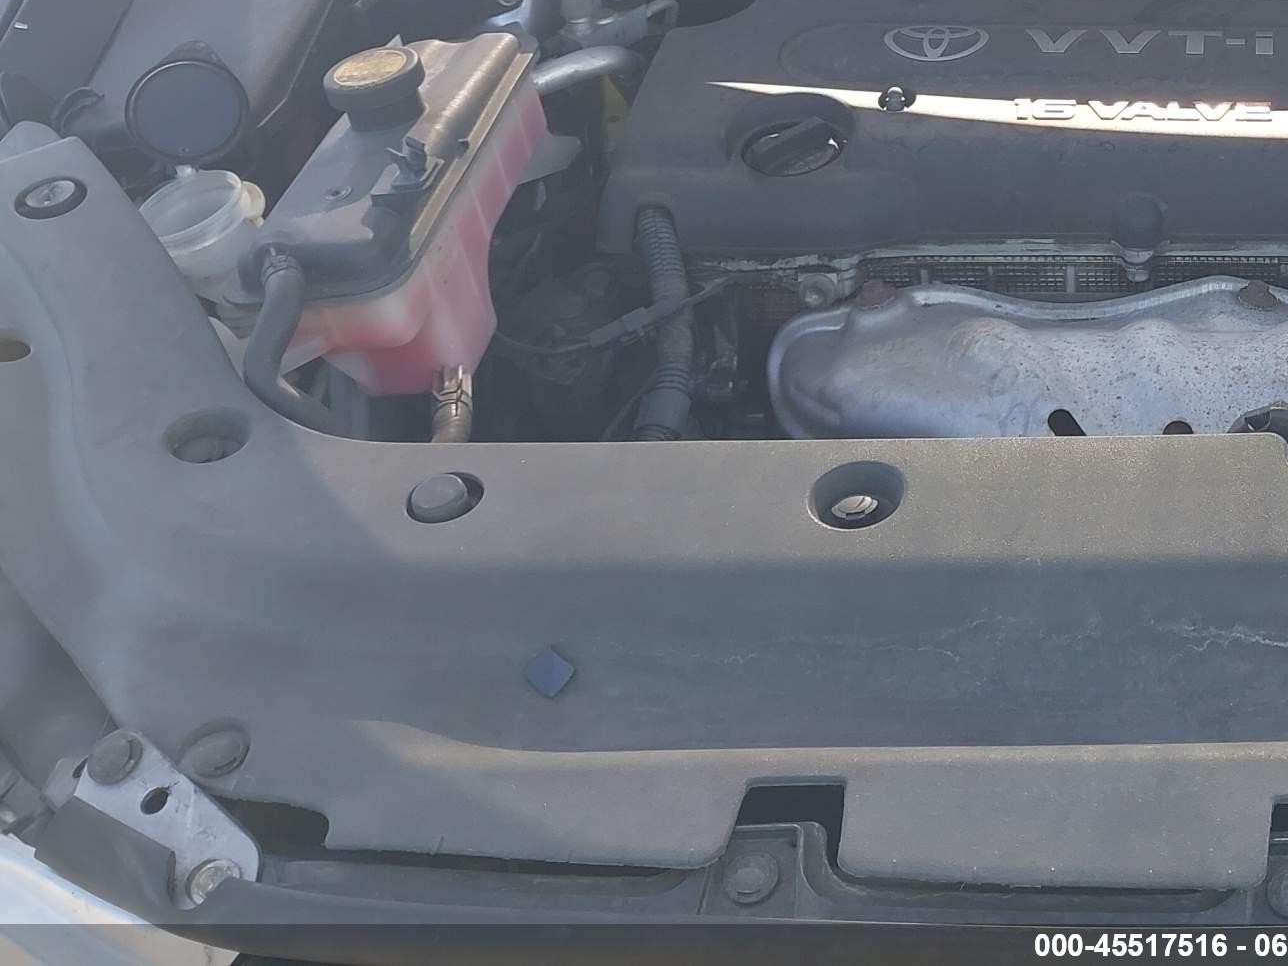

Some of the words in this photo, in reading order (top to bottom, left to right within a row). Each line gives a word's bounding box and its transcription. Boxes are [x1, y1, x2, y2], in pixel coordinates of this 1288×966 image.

[1025, 28, 1274, 55] VVT-i
[1014, 98, 1077, 121] 16
[1088, 100, 1273, 122] VALVE
